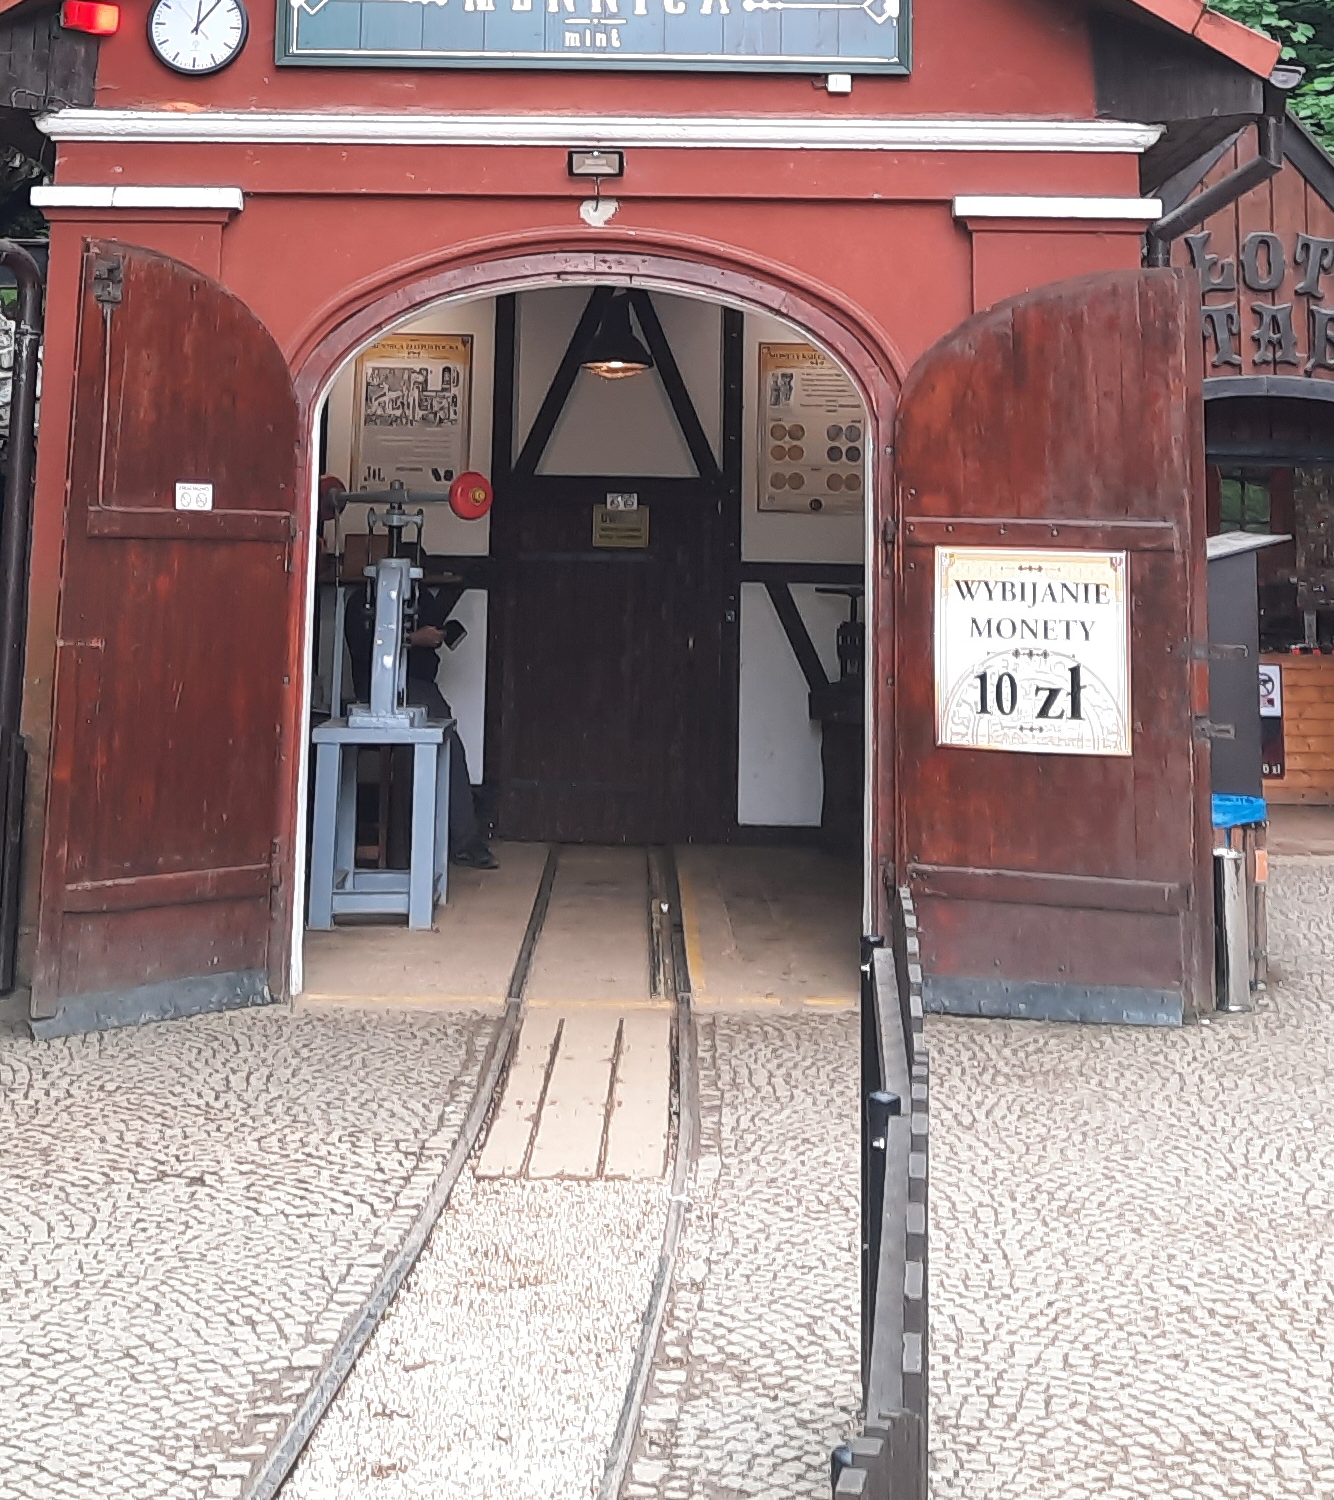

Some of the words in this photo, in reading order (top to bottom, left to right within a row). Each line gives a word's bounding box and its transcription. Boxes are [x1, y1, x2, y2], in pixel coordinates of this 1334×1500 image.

[564, 27, 622, 47] mint
[953, 579, 1111, 609] WYBIJANIE
[969, 617, 1096, 641] MONETY
[974, 670, 1018, 716] 10
[1035, 663, 1087, 721] zł
